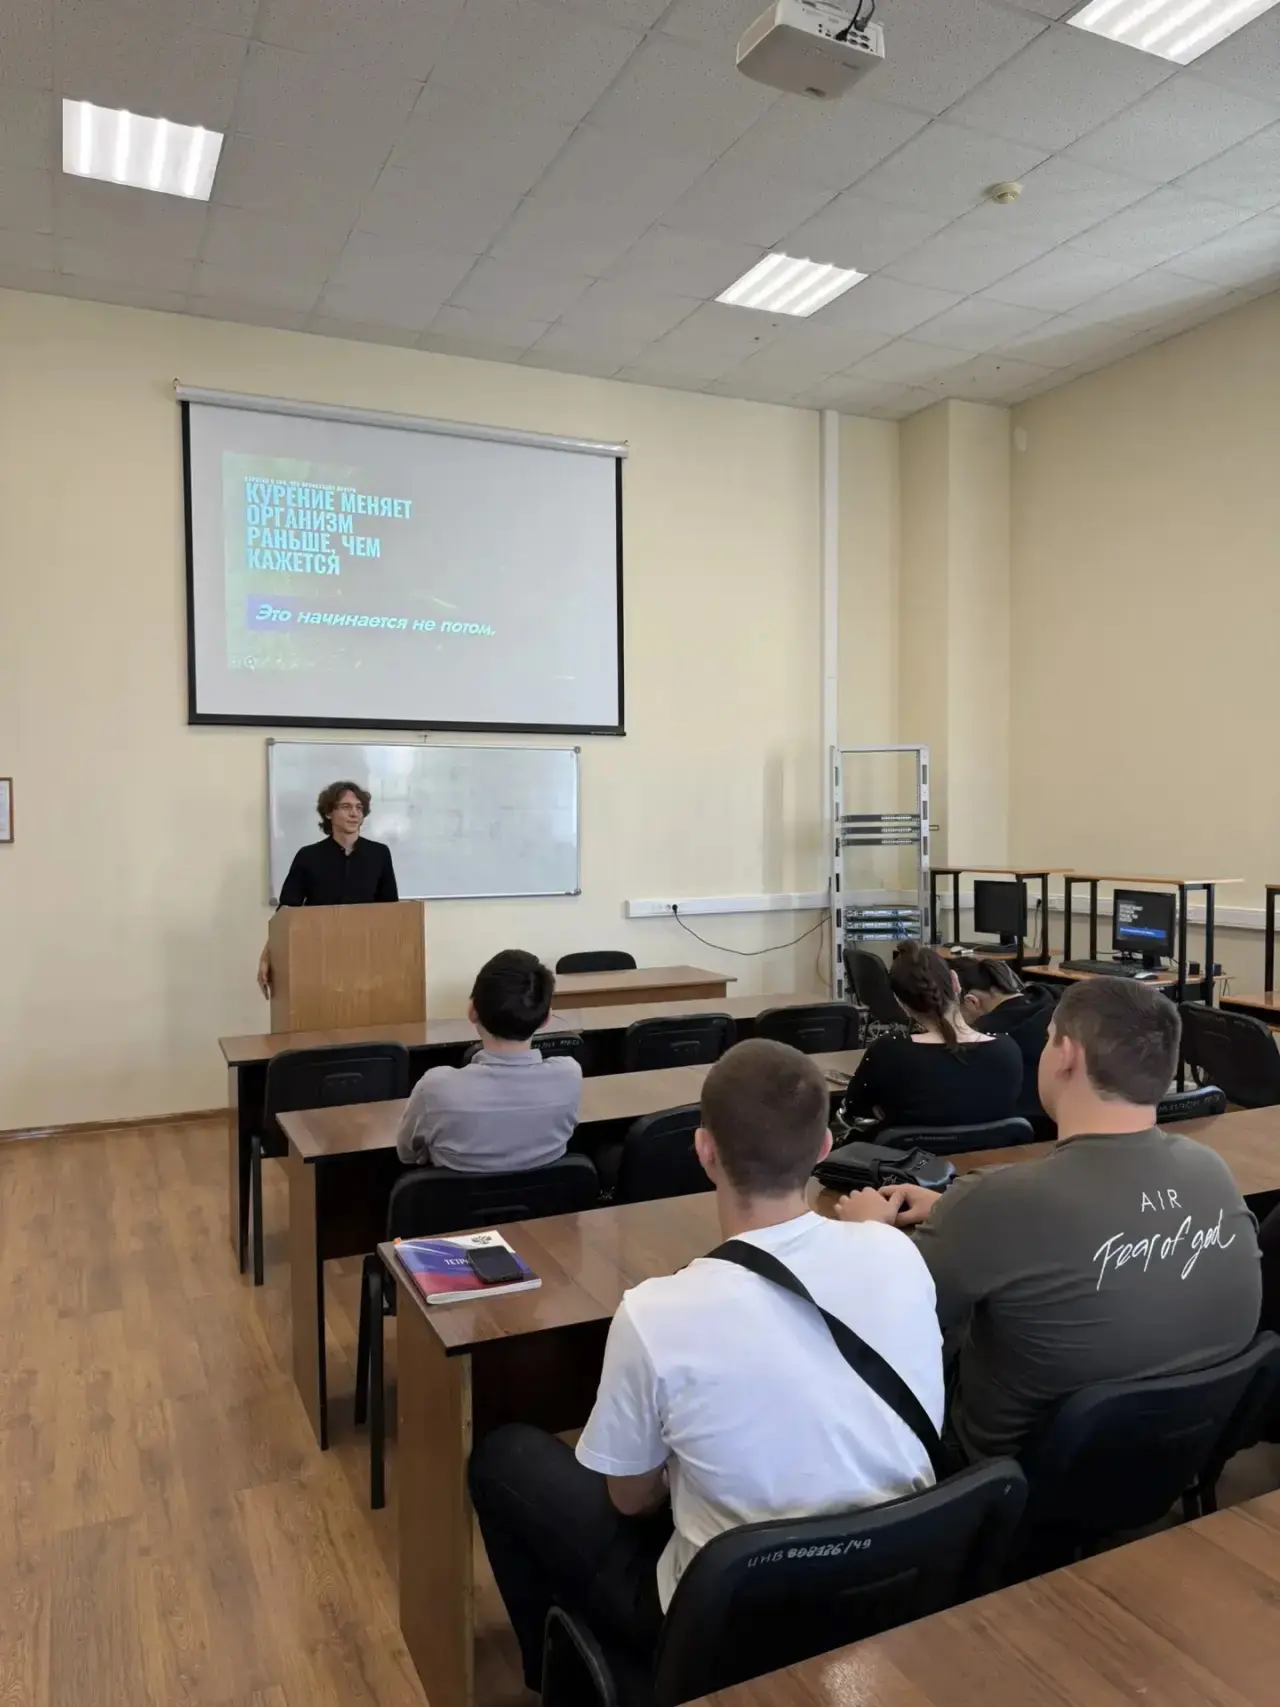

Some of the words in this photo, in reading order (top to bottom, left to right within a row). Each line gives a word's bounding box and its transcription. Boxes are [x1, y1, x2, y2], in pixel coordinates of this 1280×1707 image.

[246, 483, 335, 511] КУРЕНИЕ
[341, 492, 412, 519] МЕНЯЕТ
[246, 504, 354, 534] ОРГАНИЗМ
[341, 535, 381, 558] ЧЕМ
[246, 548, 340, 575] КАЖЕТСЯ
[255, 604, 292, 622] Это
[297, 610, 407, 630] начинается
[413, 619, 436, 632] не
[1141, 1189, 1182, 1212] AIR
[1093, 1232, 1161, 1291] Fear
[1161, 1215, 1192, 1259] of
